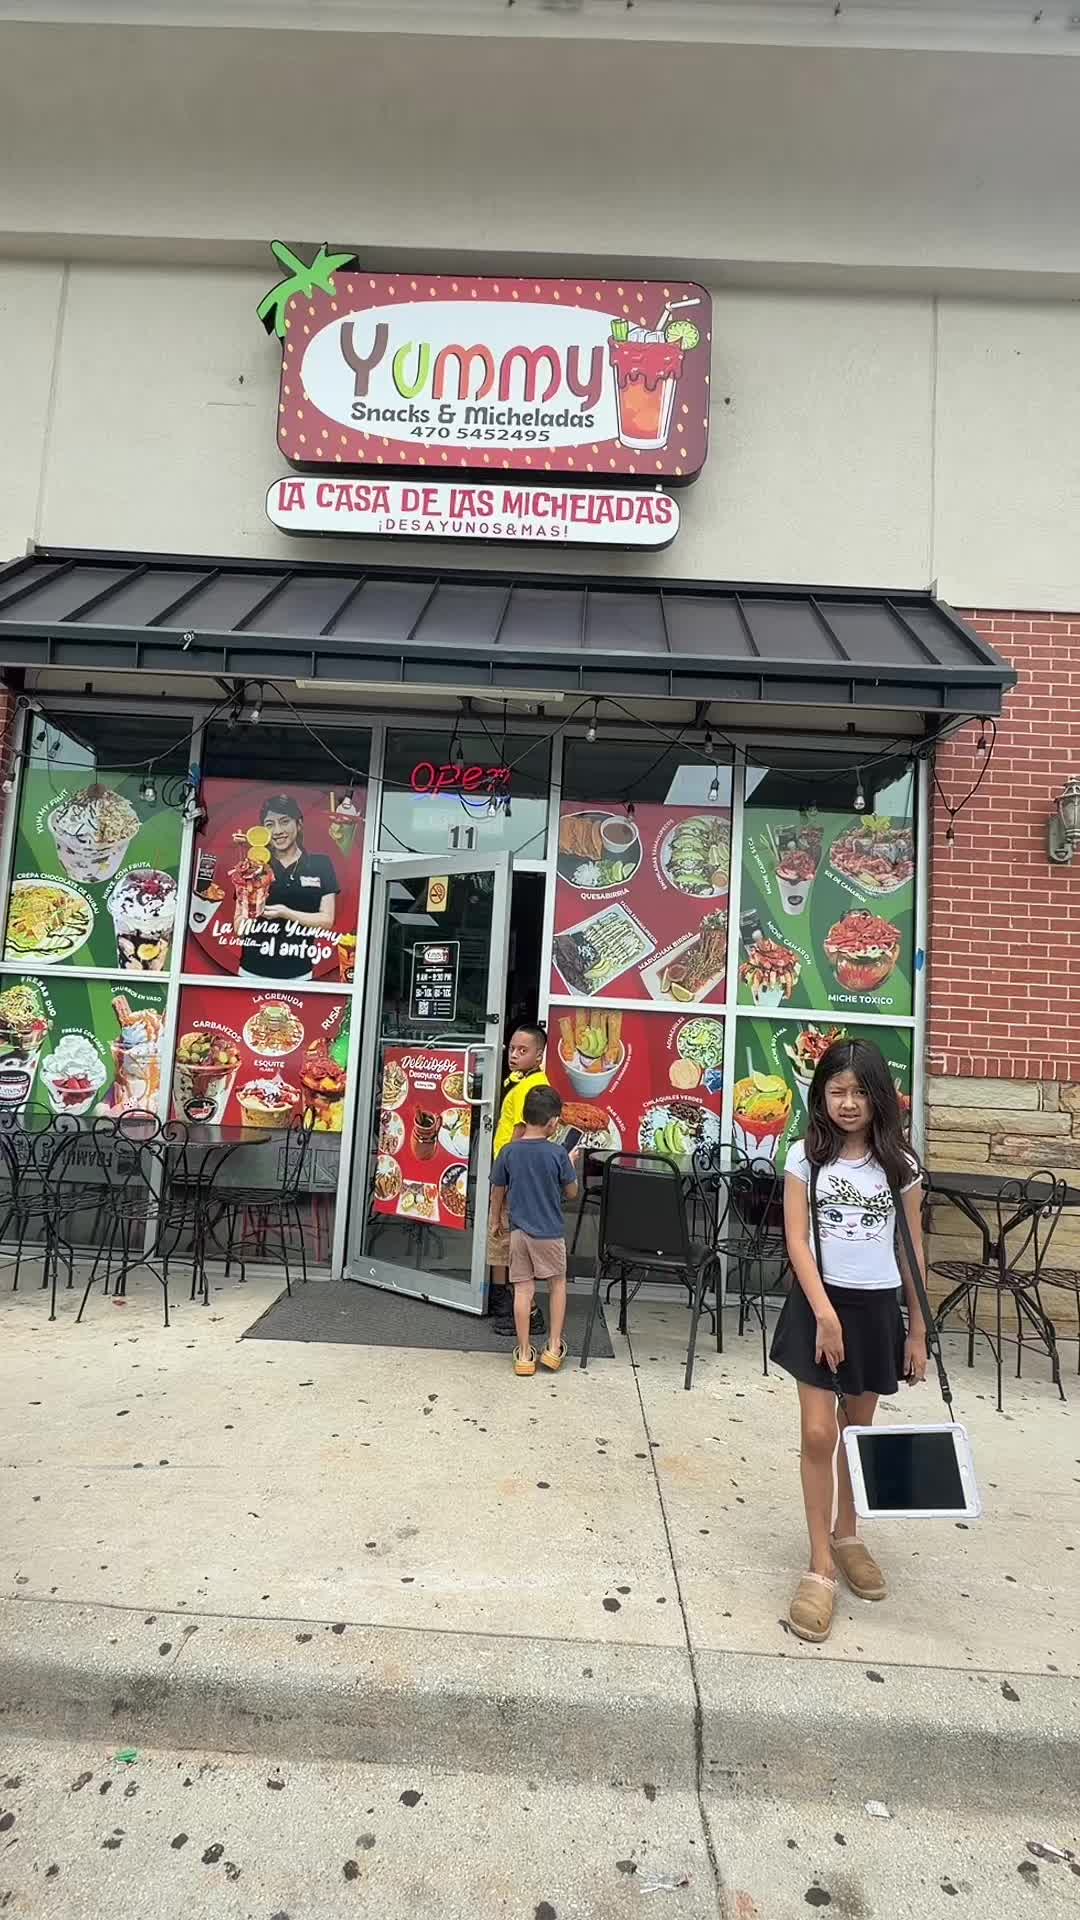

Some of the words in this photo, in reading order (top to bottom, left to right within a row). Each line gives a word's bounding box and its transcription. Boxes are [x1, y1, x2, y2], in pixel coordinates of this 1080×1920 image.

[340, 322, 604, 412] Yummy
[351, 402, 429, 423] Snacks
[438, 404, 456, 424] &
[464, 406, 595, 428] Micheladas
[410, 426, 451, 438] 470
[456, 428, 550, 443] 5452495
[278, 482, 305, 511] LA
[316, 483, 390, 514] CASA
[401, 487, 443, 516] DE
[451, 488, 493, 518] LAS
[502, 490, 672, 525] MICHELADAS
[36, 806, 50, 834] YUMMY
[49, 789, 68, 806] FRUIT
[450, 825, 475, 849] 11
[17, 872, 39, 880] CREPA
[40, 873, 79, 890] CHOCOLATE
[114, 866, 129, 880] CON
[128, 861, 151, 872] FRUTA
[580, 888, 630, 900] QUESABIRRIA
[213, 920, 233, 937] La
[285, 920, 343, 946] Yummy
[260, 937, 275, 957] al
[279, 939, 332, 965] antojo
[638, 944, 673, 971] MARUCHAN
[672, 932, 694, 948] BIRRIA
[21, 976, 50, 998] FRESAS
[45, 1000, 56, 1017] DUO
[145, 995, 162, 1003] VASO
[252, 994, 264, 1004] LA
[828, 994, 859, 1004] MICHE
[860, 995, 894, 1005] TOXICO
[321, 1006, 342, 1031] RUSA
[192, 1020, 243, 1043] GARBANZOS
[254, 1060, 285, 1068] ESQUITE
[401, 1054, 458, 1073] Deliciosos
[887, 1060, 907, 1071] FRUIT
[409, 1070, 442, 1080] Desayunos
